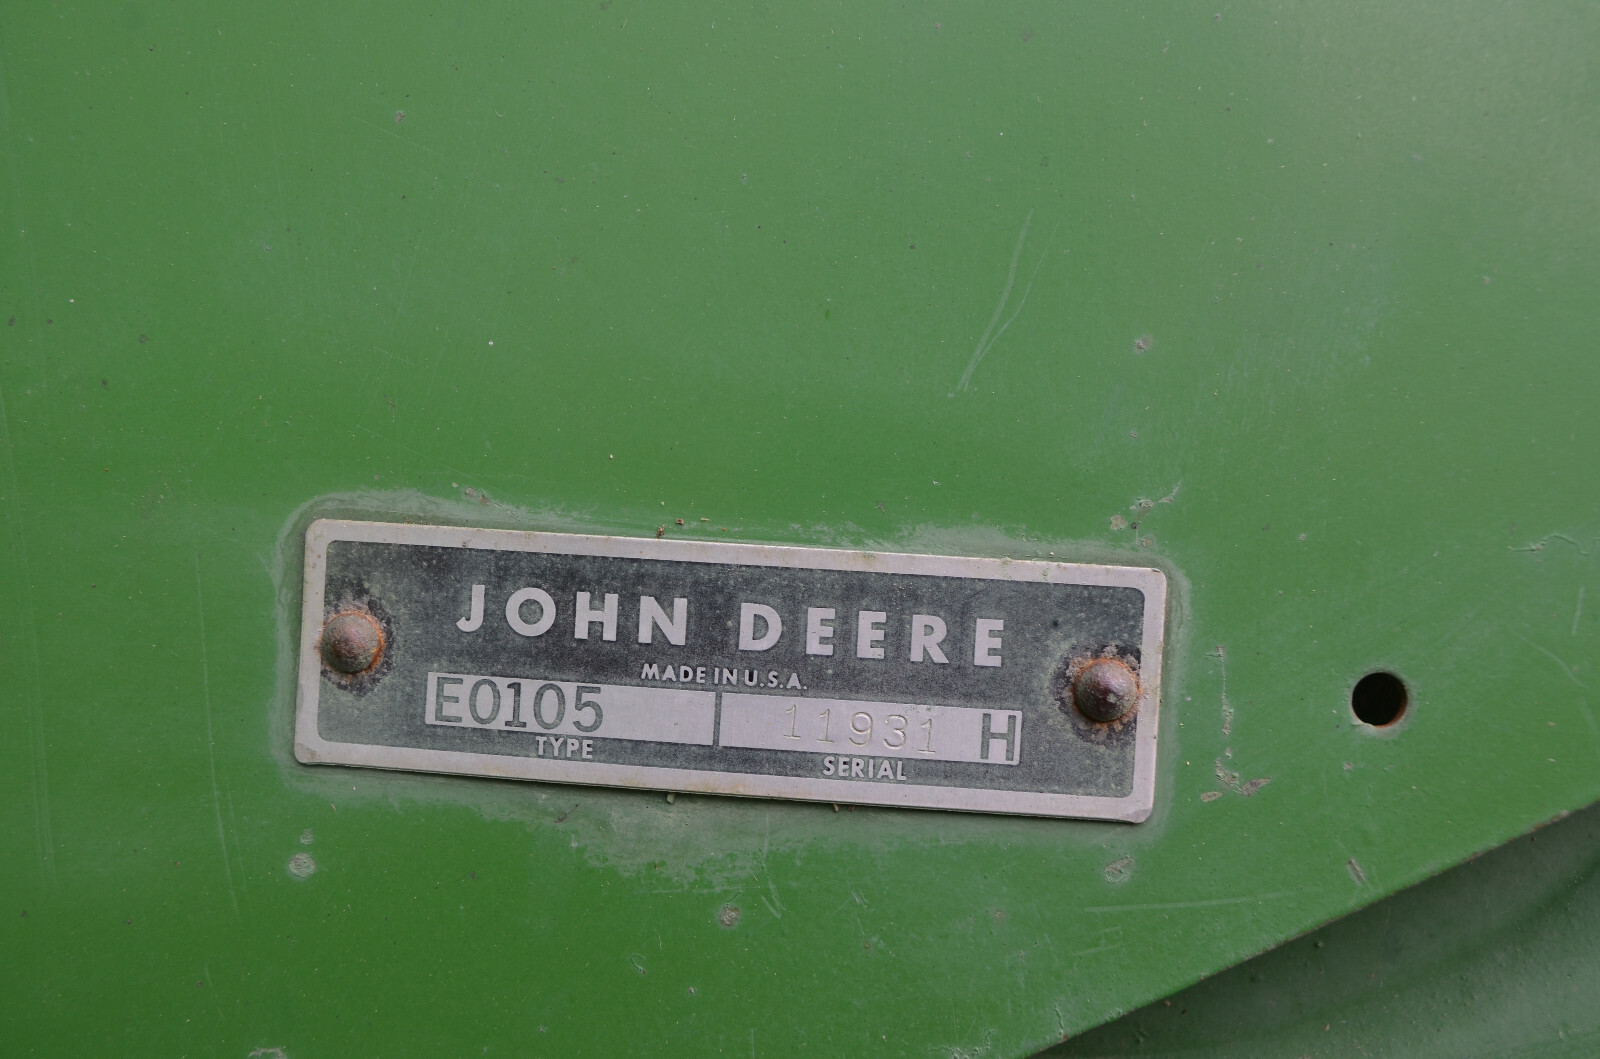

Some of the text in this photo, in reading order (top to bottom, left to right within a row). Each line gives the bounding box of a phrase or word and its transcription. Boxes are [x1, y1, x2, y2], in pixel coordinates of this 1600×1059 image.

[456, 584, 1004, 667] JOHN DEERE
[640, 663, 808, 690] MADE IN U.S.A.
[434, 676, 604, 733] E0105
[535, 736, 594, 759] TYPE
[783, 703, 1017, 762] 11931 H
[822, 756, 907, 781] SERIAL
